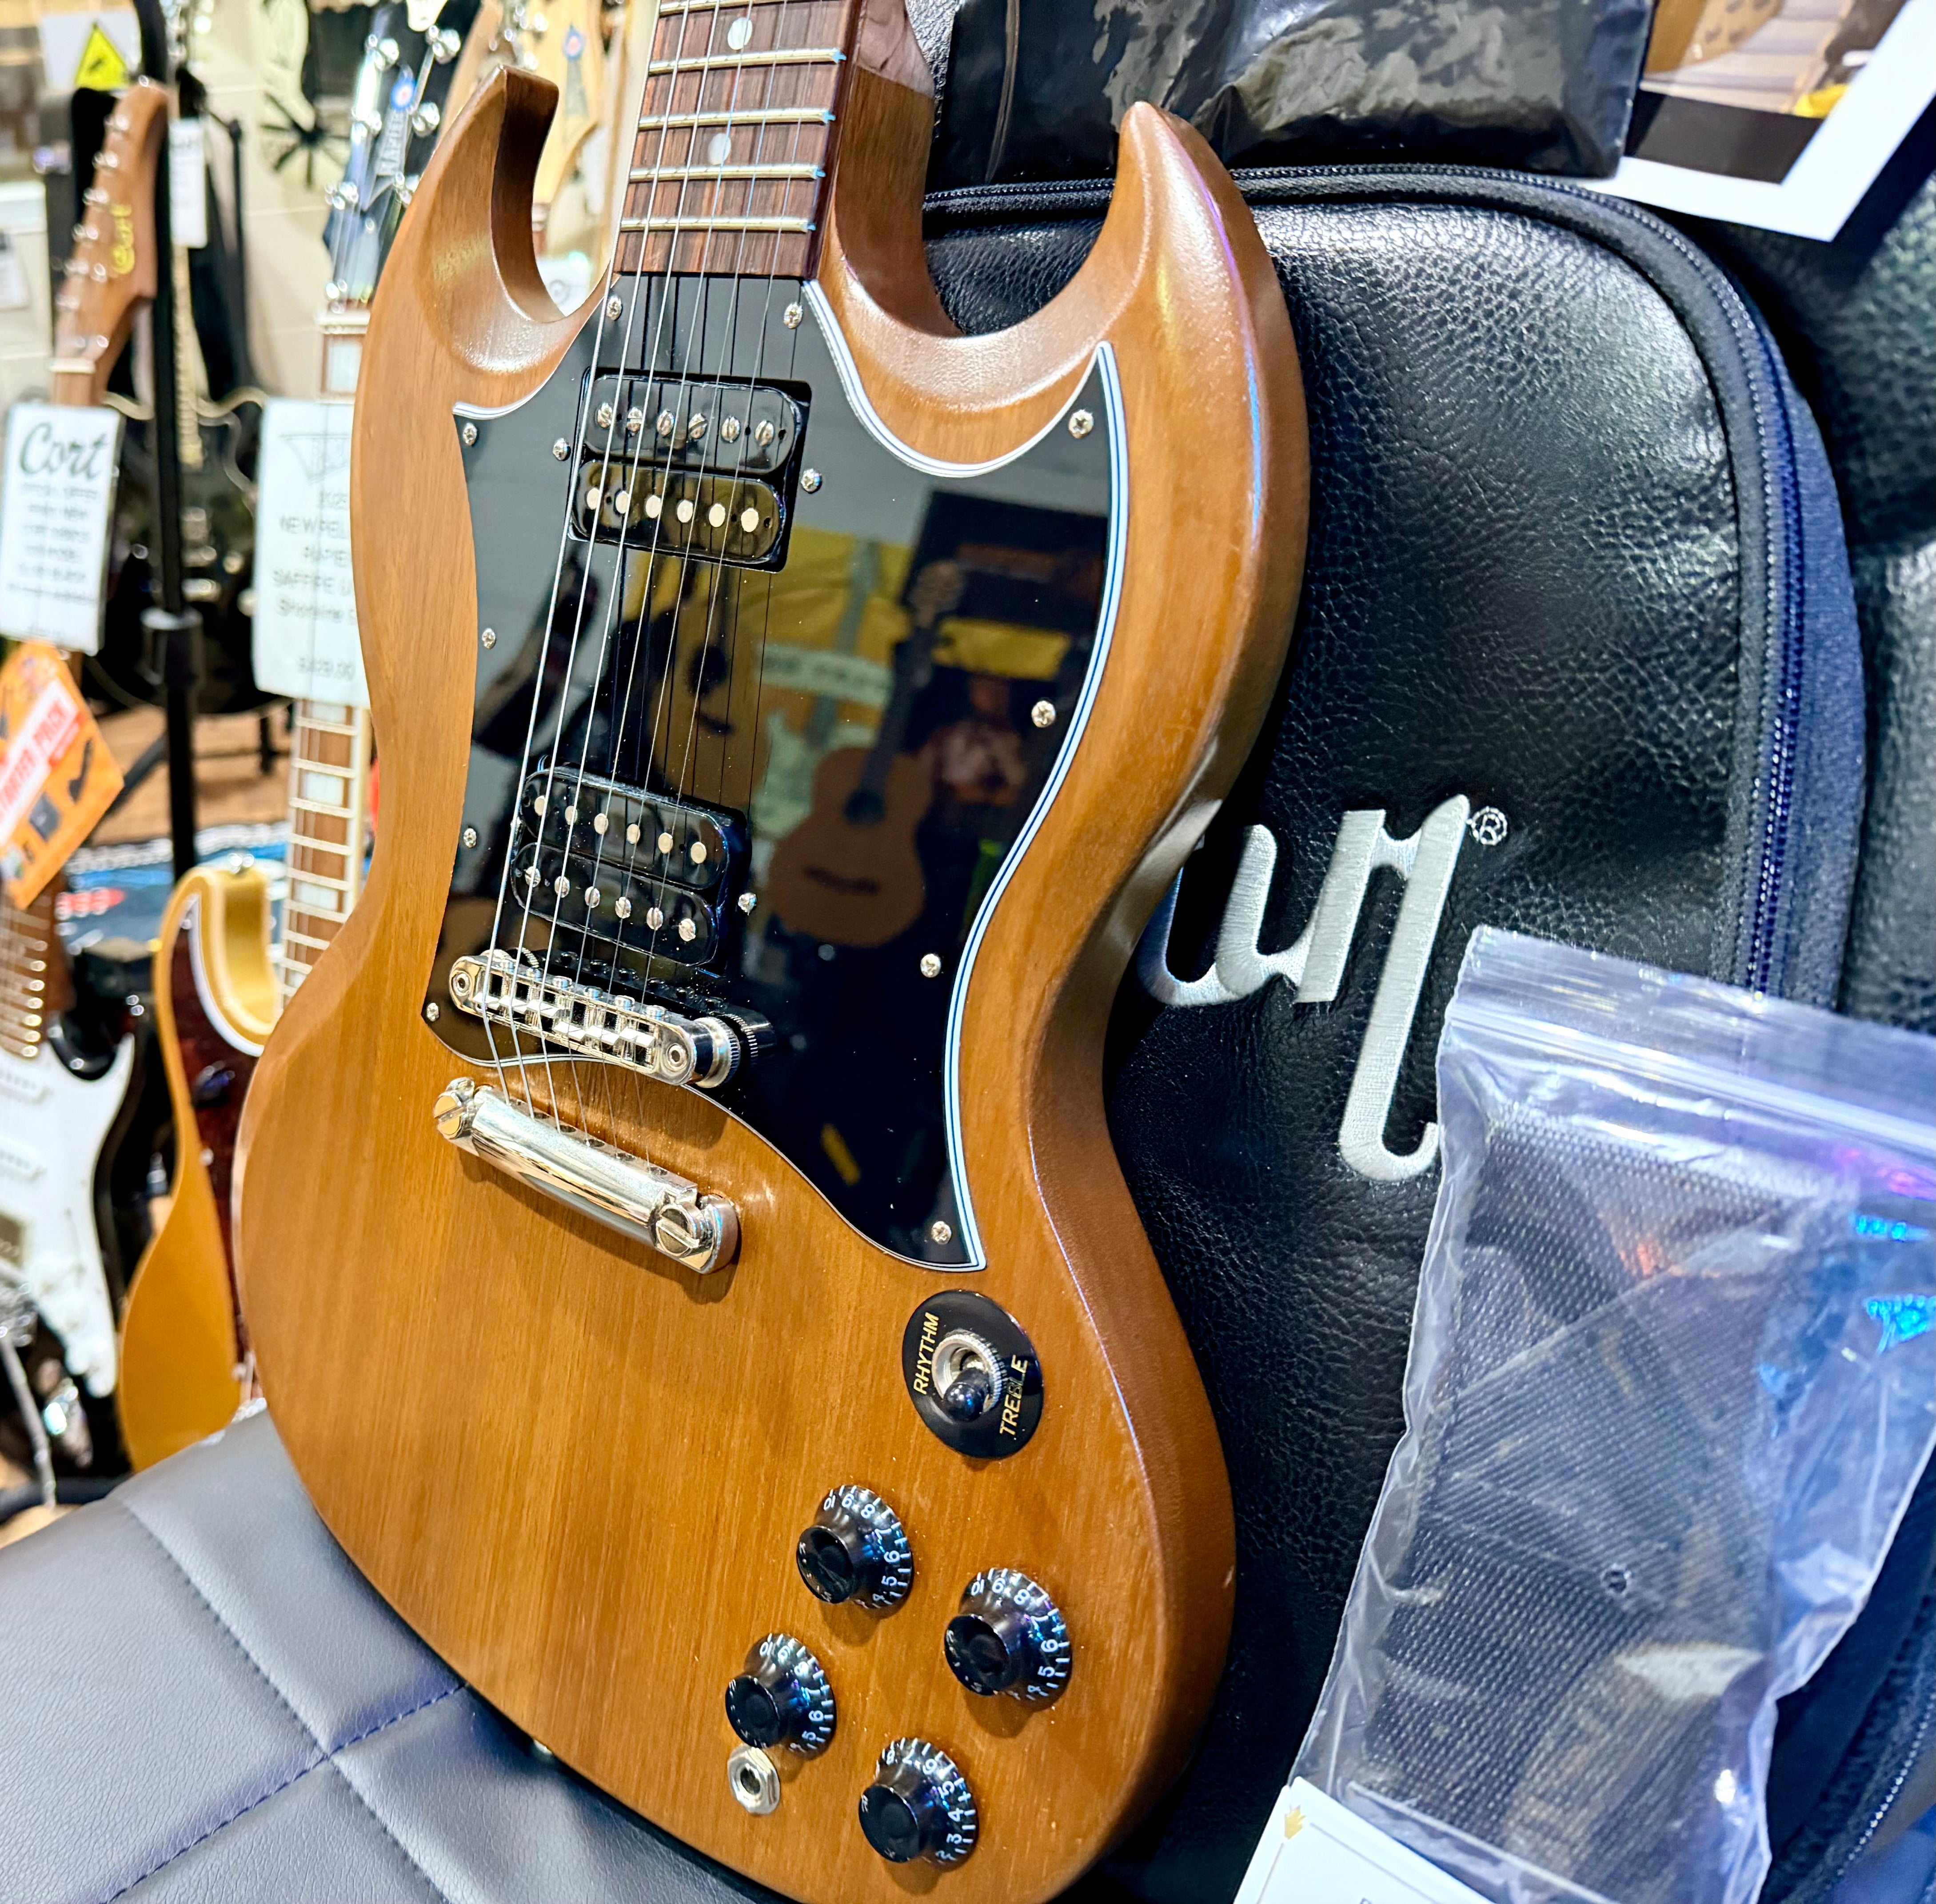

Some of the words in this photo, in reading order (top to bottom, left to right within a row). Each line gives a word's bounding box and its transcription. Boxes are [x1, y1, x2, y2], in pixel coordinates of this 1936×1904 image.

[111, 204, 135, 275] Cort
[19, 422, 110, 480] Cort
[913, 1312, 939, 1395] RHYTHM
[999, 1354, 1028, 1436] TREBLE
[861, 1504, 875, 1519] 8
[882, 1575, 898, 1587] 5
[1014, 1589, 1031, 1605] 8
[1038, 1666, 1055, 1677] 5
[802, 1730, 816, 1741] 5
[886, 1749, 895, 1765] 8
[938, 1780, 955, 1799] 5
[948, 1808, 964, 1822] 4
[946, 1833, 962, 1844] 3
